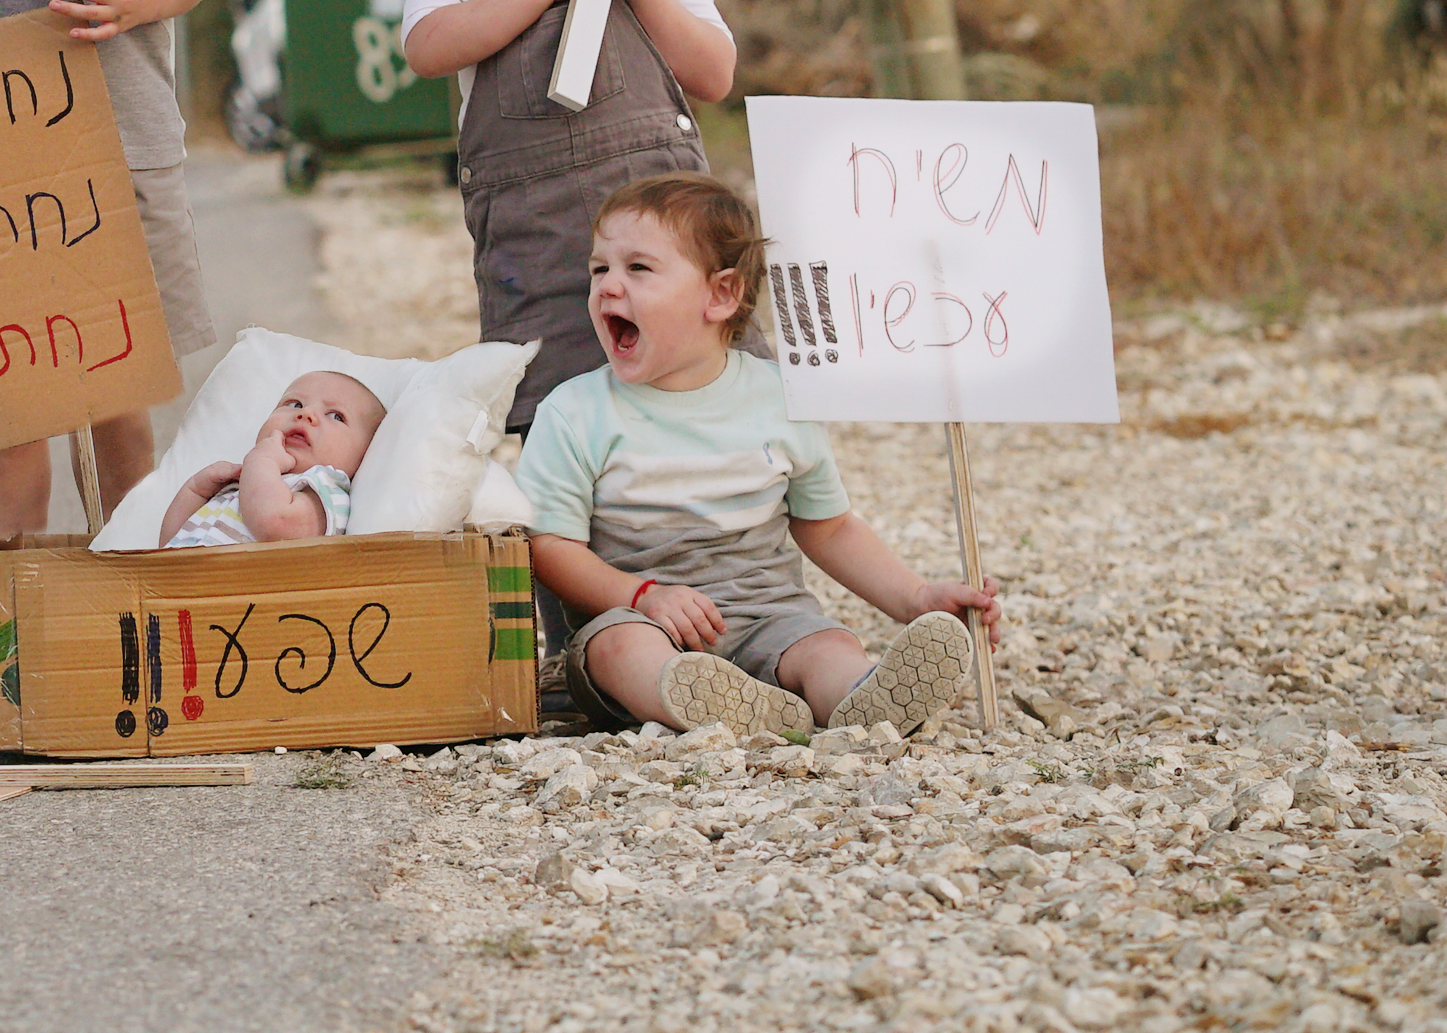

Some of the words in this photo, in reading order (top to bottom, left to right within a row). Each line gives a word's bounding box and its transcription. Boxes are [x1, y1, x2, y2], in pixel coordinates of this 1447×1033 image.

[847, 142, 1049, 236] משיח
[769, 259, 1009, 368] עכשיו!!!
[115, 602, 413, 738] שפע!!!
